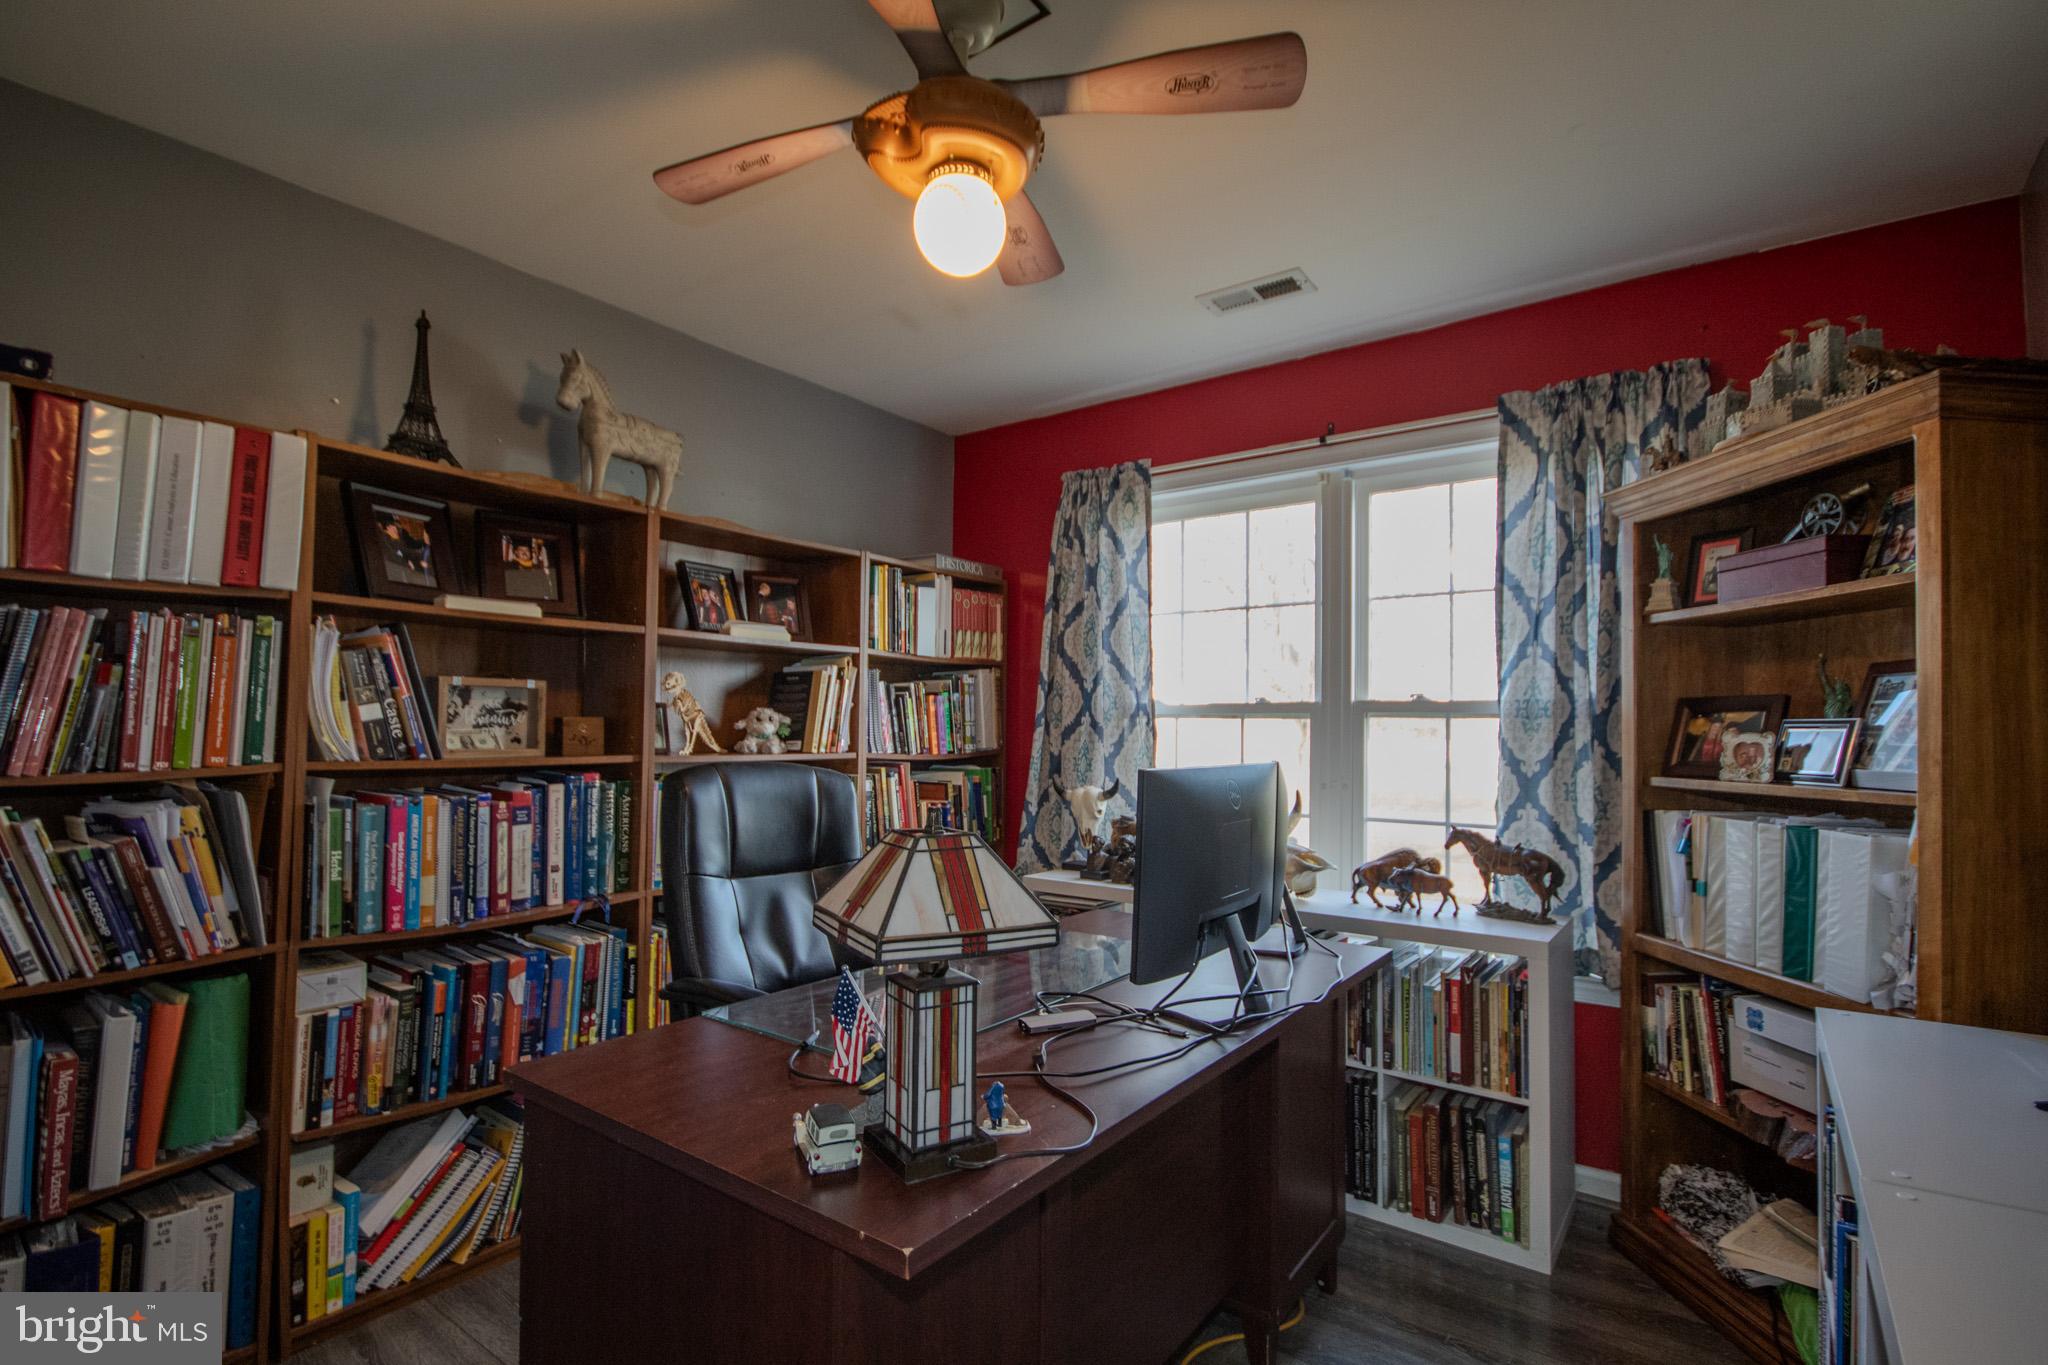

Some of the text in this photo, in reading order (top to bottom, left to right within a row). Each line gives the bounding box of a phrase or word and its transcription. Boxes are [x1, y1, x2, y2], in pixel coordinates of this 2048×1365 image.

[382, 696, 405, 740] Caste
[330, 850, 342, 881] Herbal
[80, 884, 111, 940] LEADERSHIP
[53, 1069, 74, 1111] Mayas,
[53, 1112, 70, 1148] Incas,
[53, 1149, 63, 1167] and
